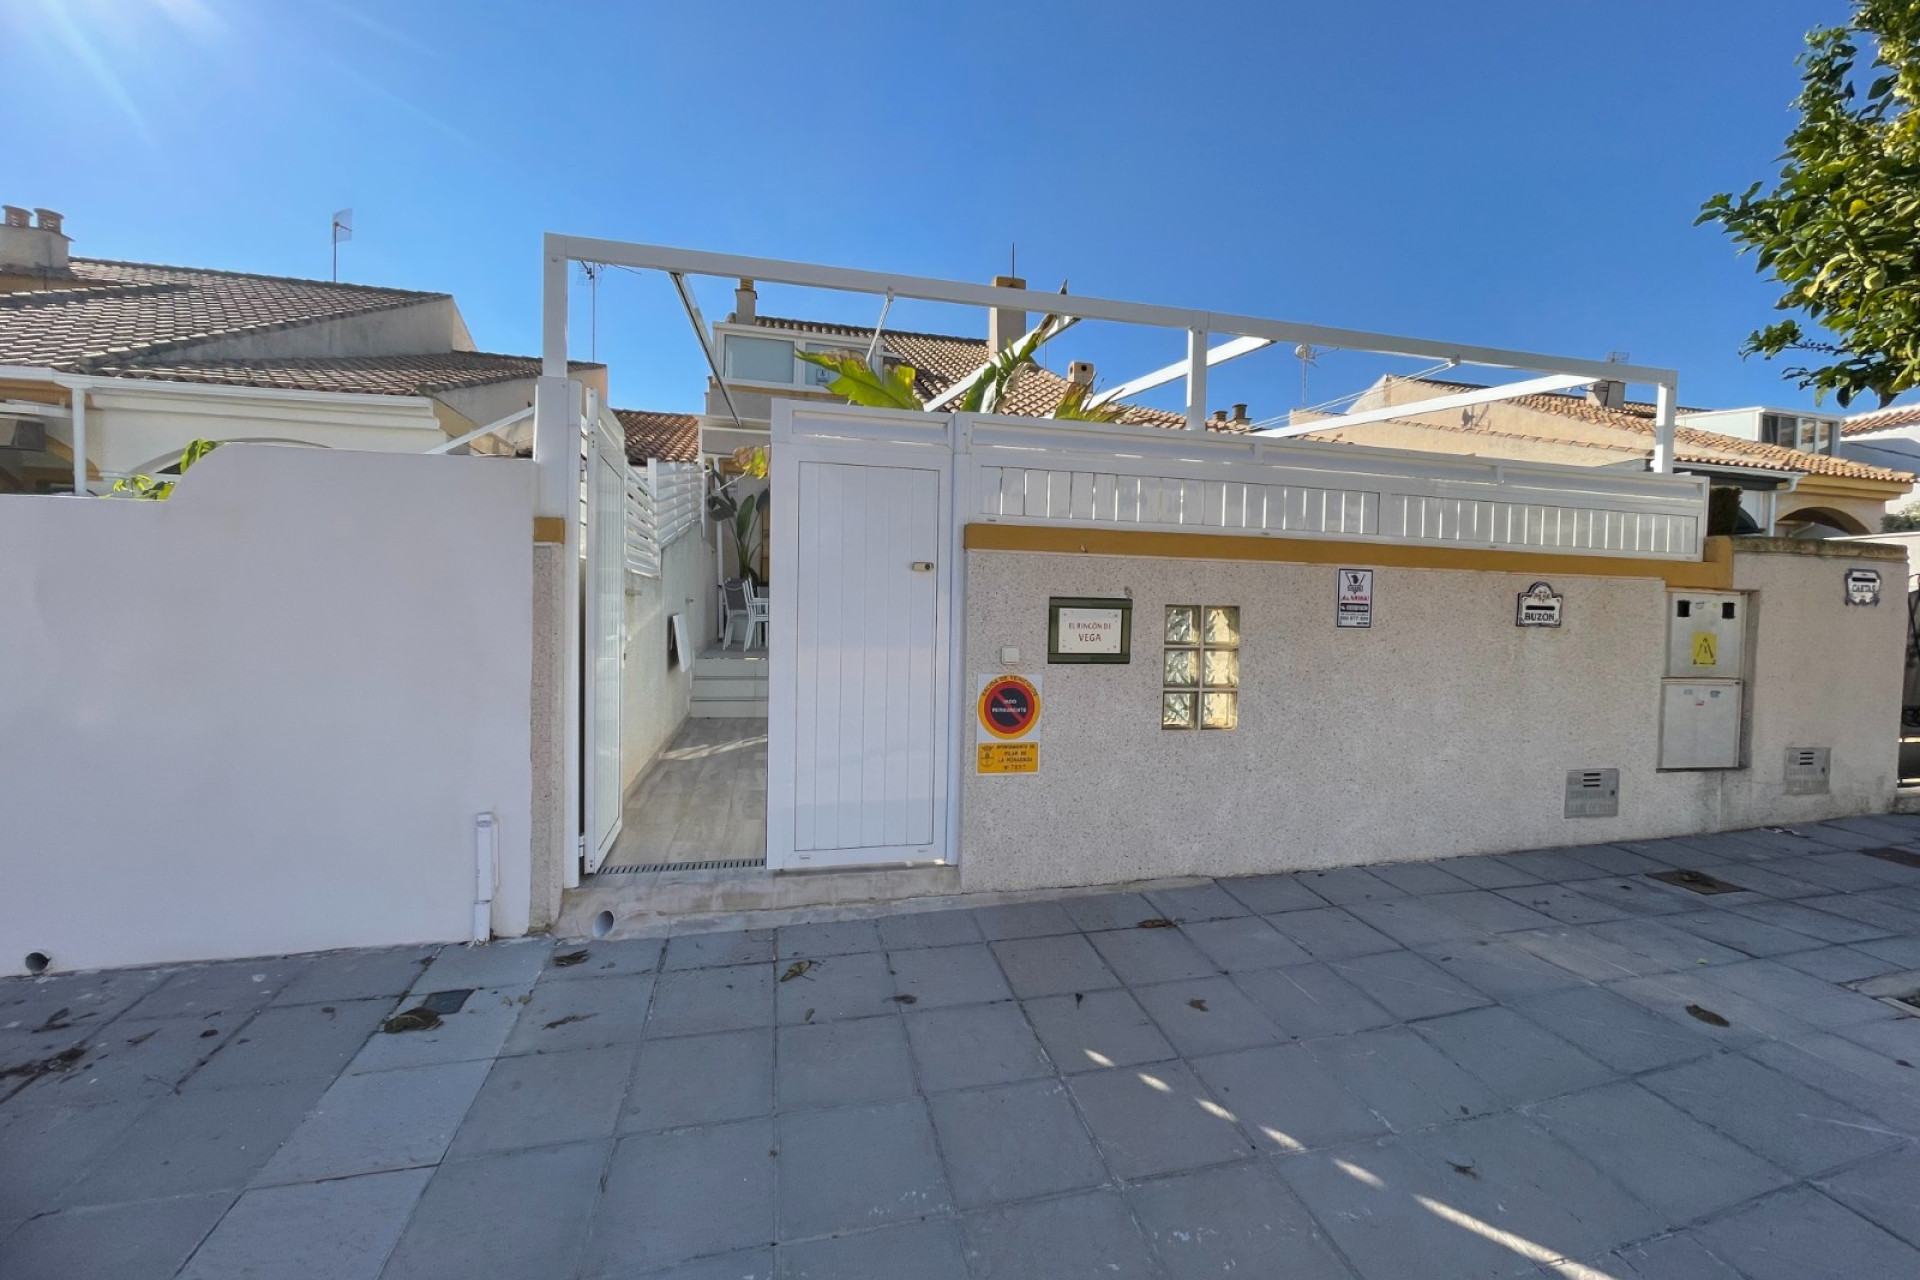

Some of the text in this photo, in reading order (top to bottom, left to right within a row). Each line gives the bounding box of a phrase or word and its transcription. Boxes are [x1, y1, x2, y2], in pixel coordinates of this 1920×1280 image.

[1069, 622, 1076, 630] EL
[1077, 621, 1102, 630] RINCÓN
[1078, 633, 1102, 642] VEGA
